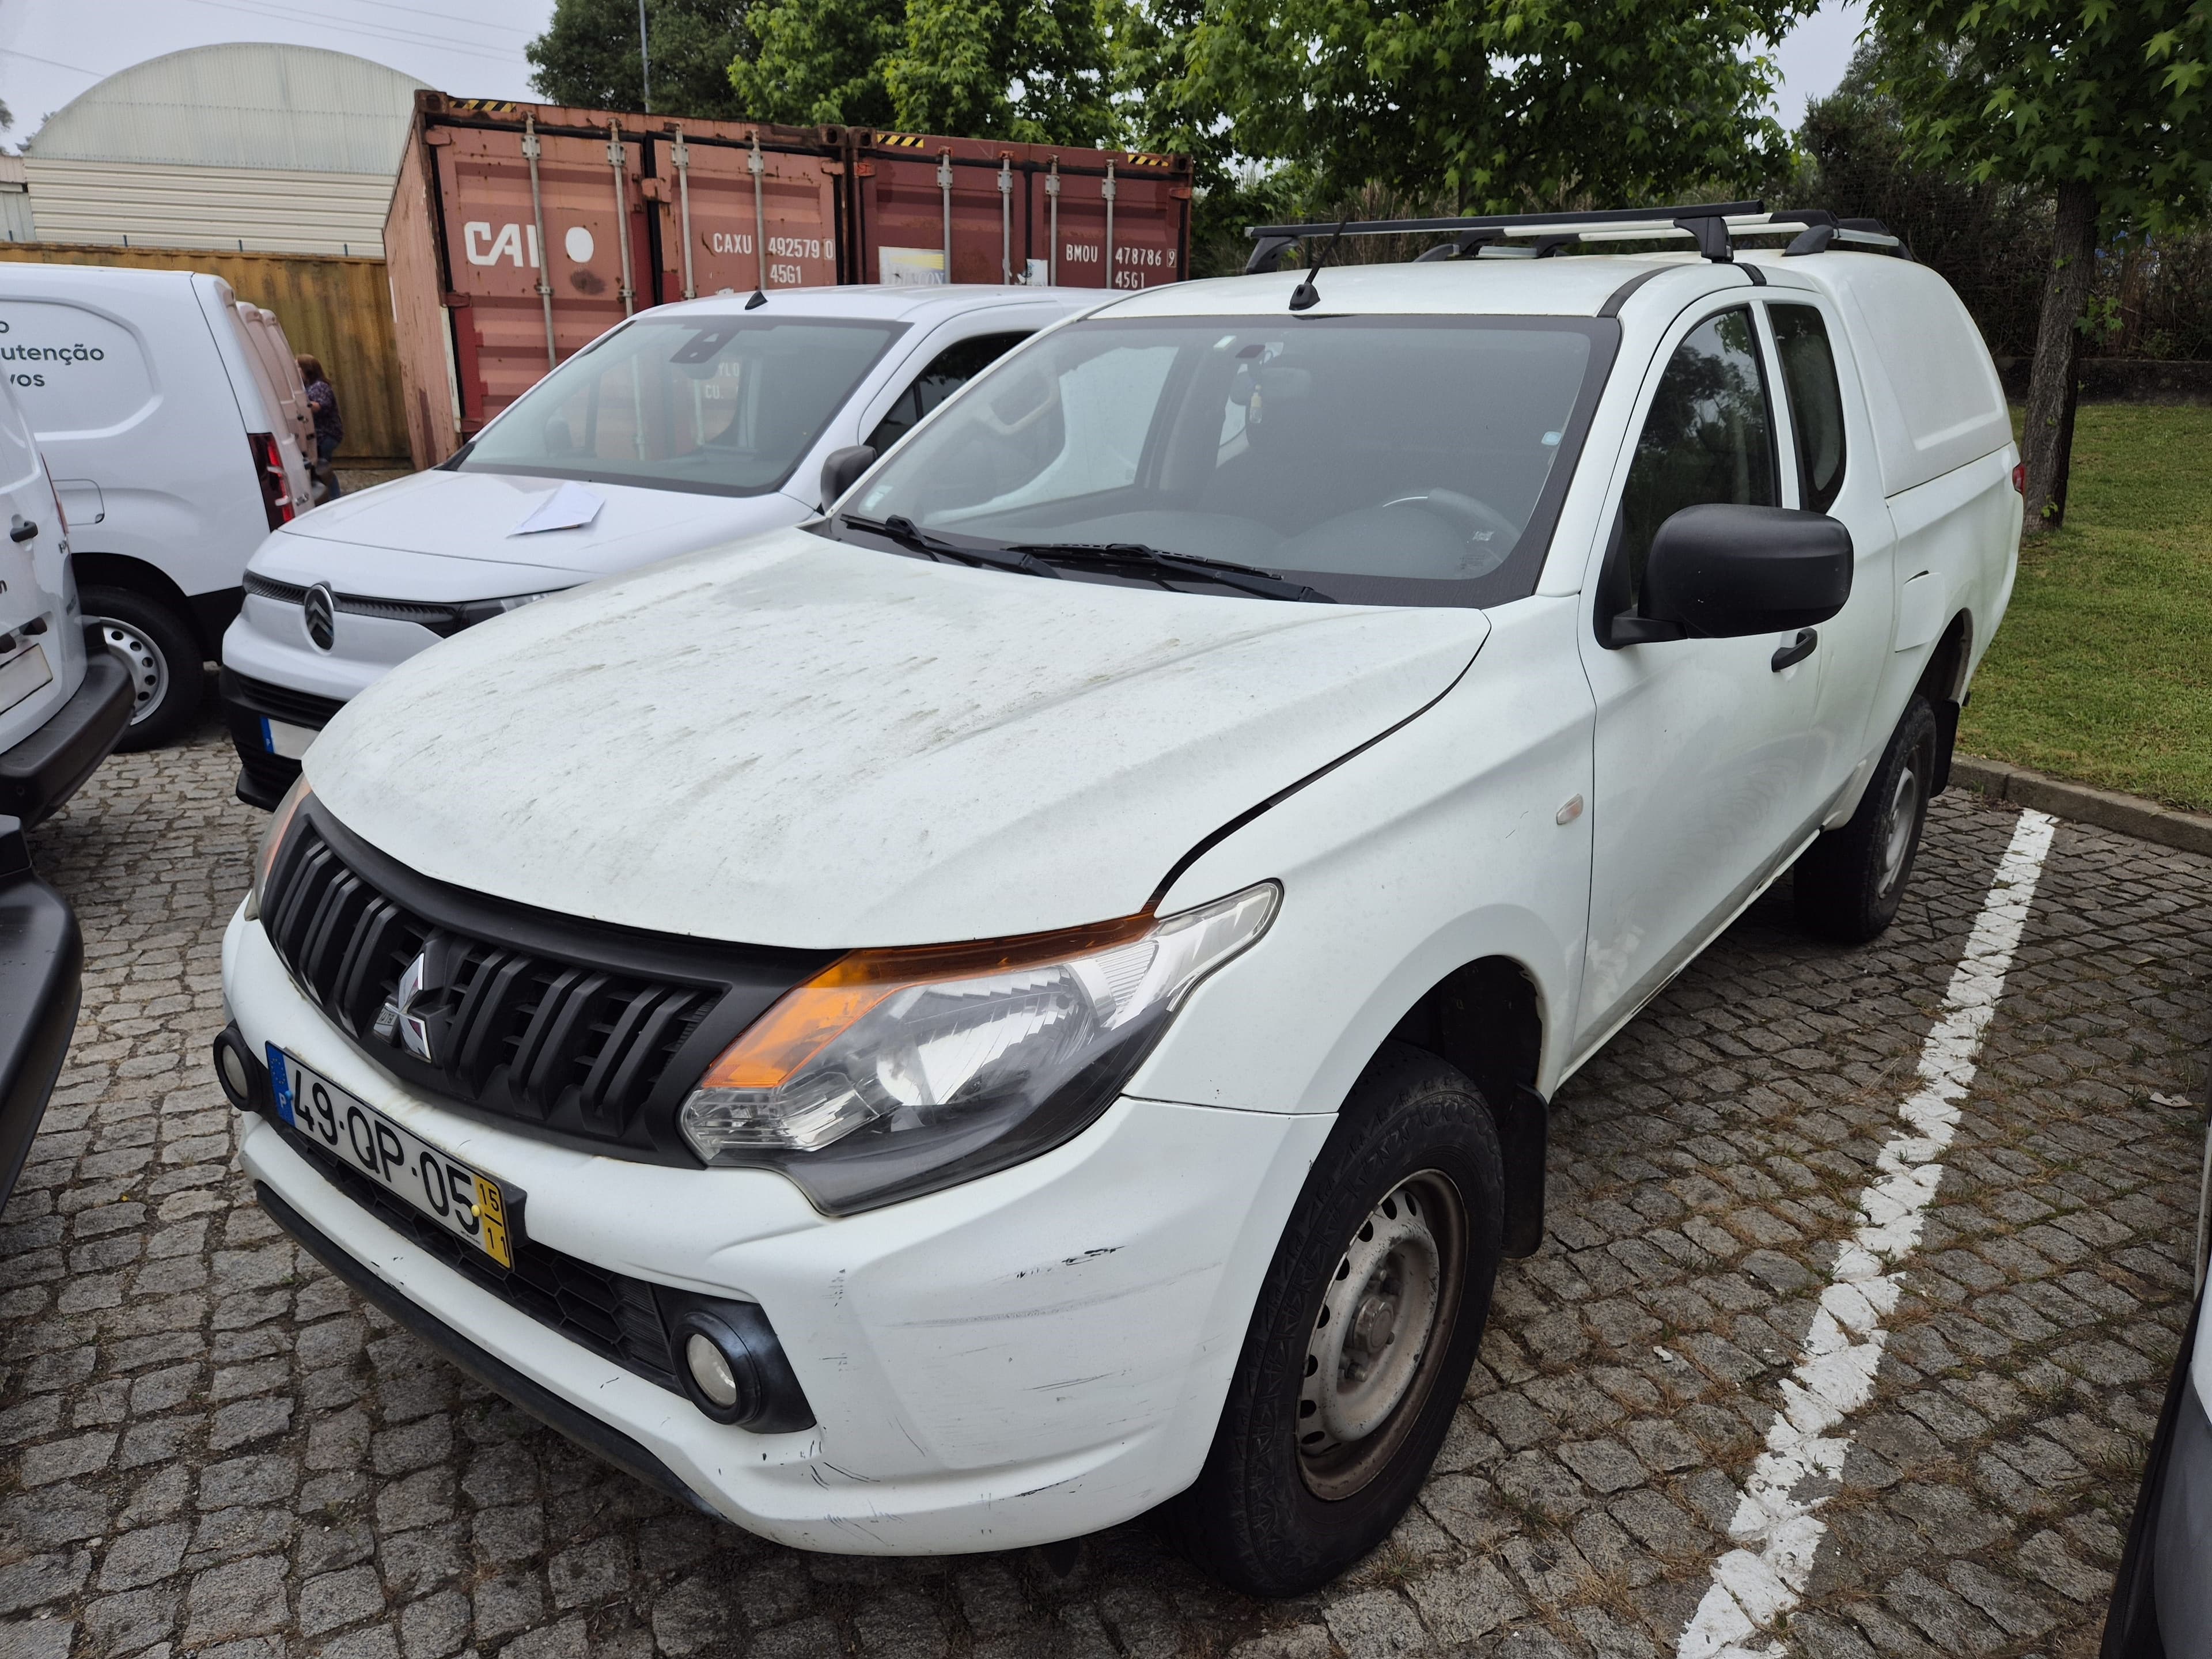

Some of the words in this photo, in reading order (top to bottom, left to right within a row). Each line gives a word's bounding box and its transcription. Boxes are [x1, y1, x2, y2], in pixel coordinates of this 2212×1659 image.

[464, 221, 540, 268] CAI
[713, 233, 752, 254] CAXU
[768, 237, 820, 259] 492579
[1066, 244, 1099, 263] BMOU
[1115, 247, 1162, 266] 478786
[770, 264, 802, 283] 45G1
[1115, 271, 1145, 289] 45G1
[0, 320, 9, 333] o
[0, 343, 104, 365] utenção
[719, 362, 740, 376] YLO
[278, 1092, 287, 1108] P
[479, 1183, 499, 1212] 15
[487, 1227, 508, 1259] 11
